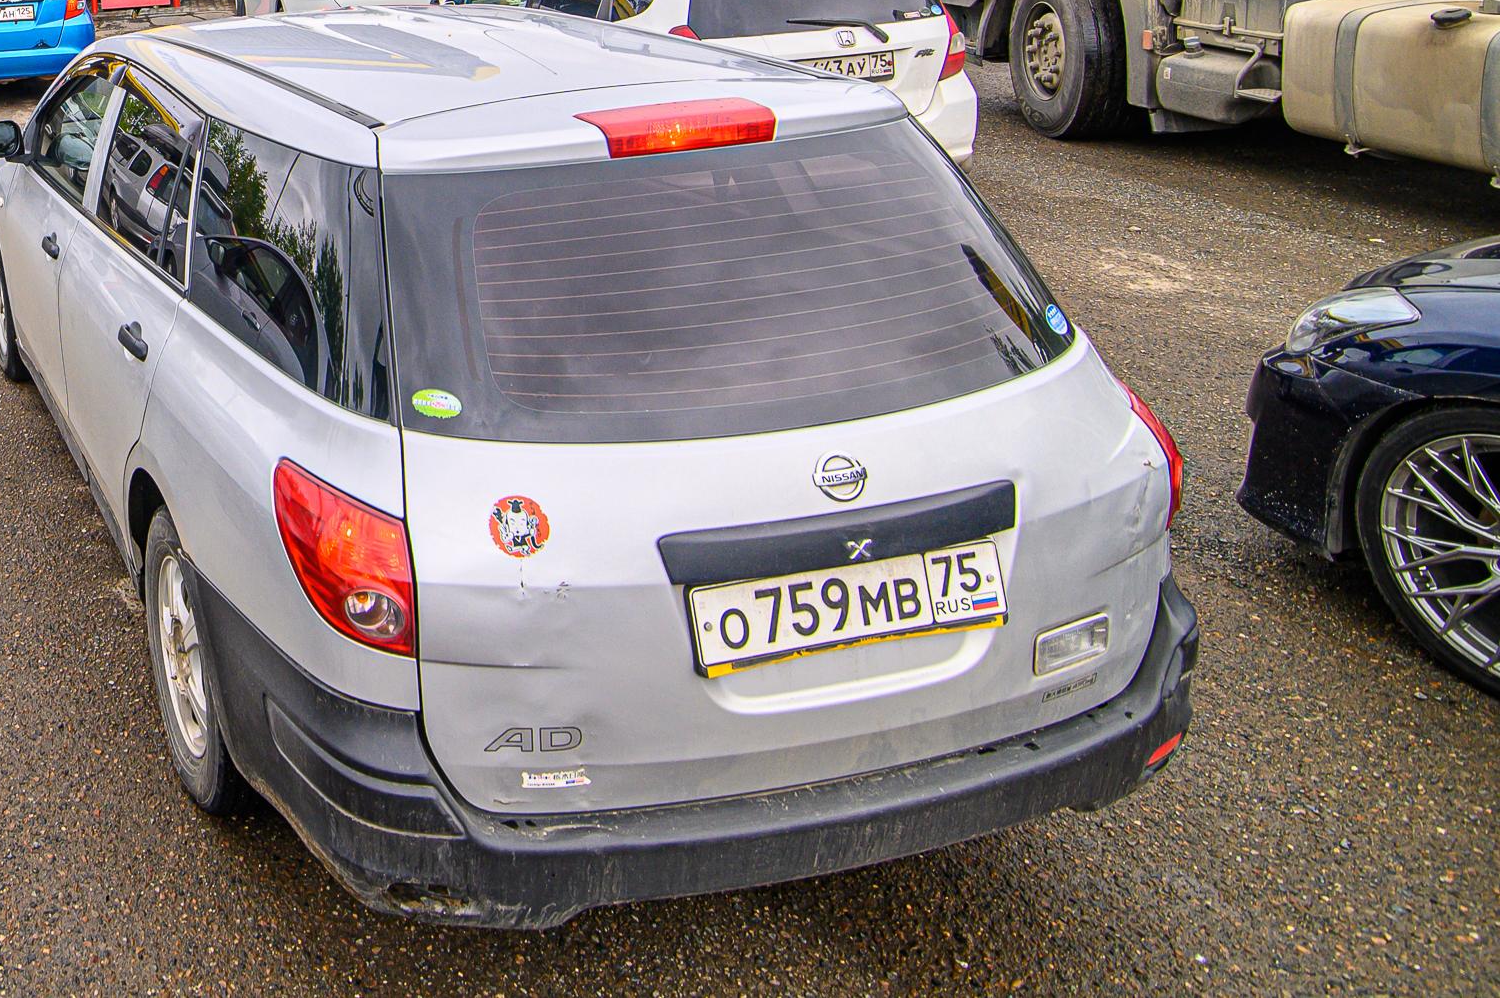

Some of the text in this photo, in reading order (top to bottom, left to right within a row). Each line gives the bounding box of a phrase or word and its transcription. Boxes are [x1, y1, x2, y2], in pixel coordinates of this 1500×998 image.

[16, 7, 31, 16] 125
[871, 54, 888, 69] 75
[821, 469, 865, 484] NISSAN
[719, 551, 981, 650] О759МВ 75 RUS
[483, 726, 583, 753] AD
